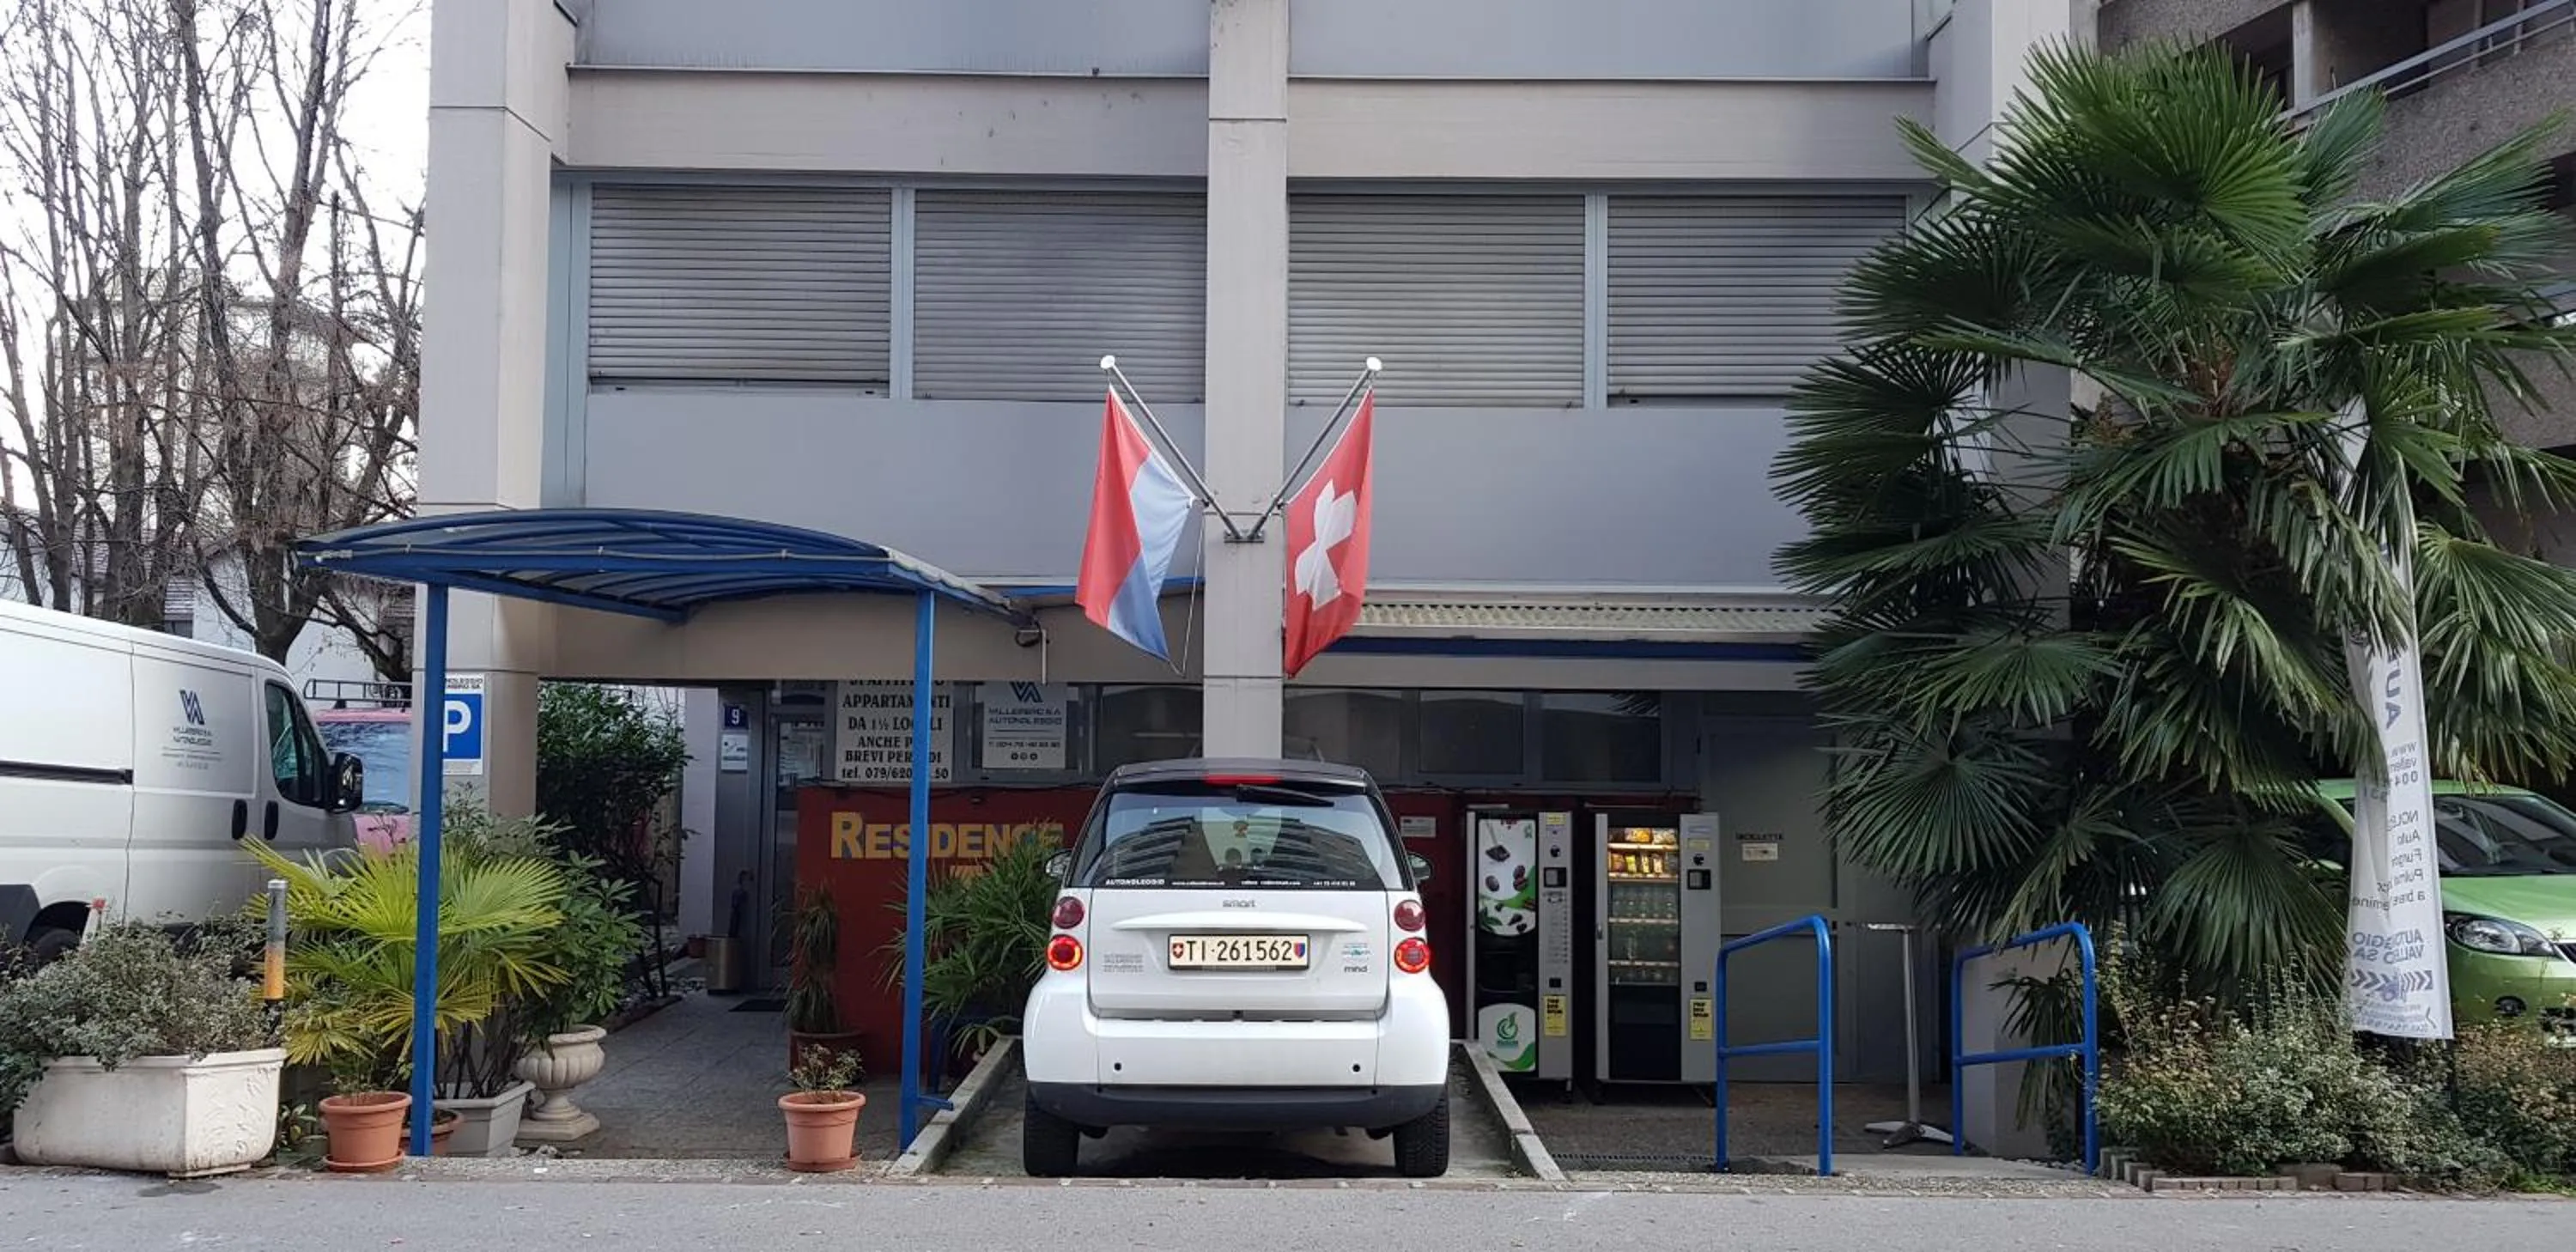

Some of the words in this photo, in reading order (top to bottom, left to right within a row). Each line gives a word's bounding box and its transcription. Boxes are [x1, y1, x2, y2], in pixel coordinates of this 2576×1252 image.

[842, 694, 951, 708] APPARTANTI
[731, 708, 740, 726] 9
[848, 716, 866, 731] DA
[893, 716, 942, 731] LOLI
[442, 700, 471, 753] P
[858, 736, 901, 749] ANCHE
[845, 750, 884, 763] BREVI
[888, 750, 941, 763] PERDI
[841, 766, 861, 779] tel.
[1222, 899, 1256, 908] smart
